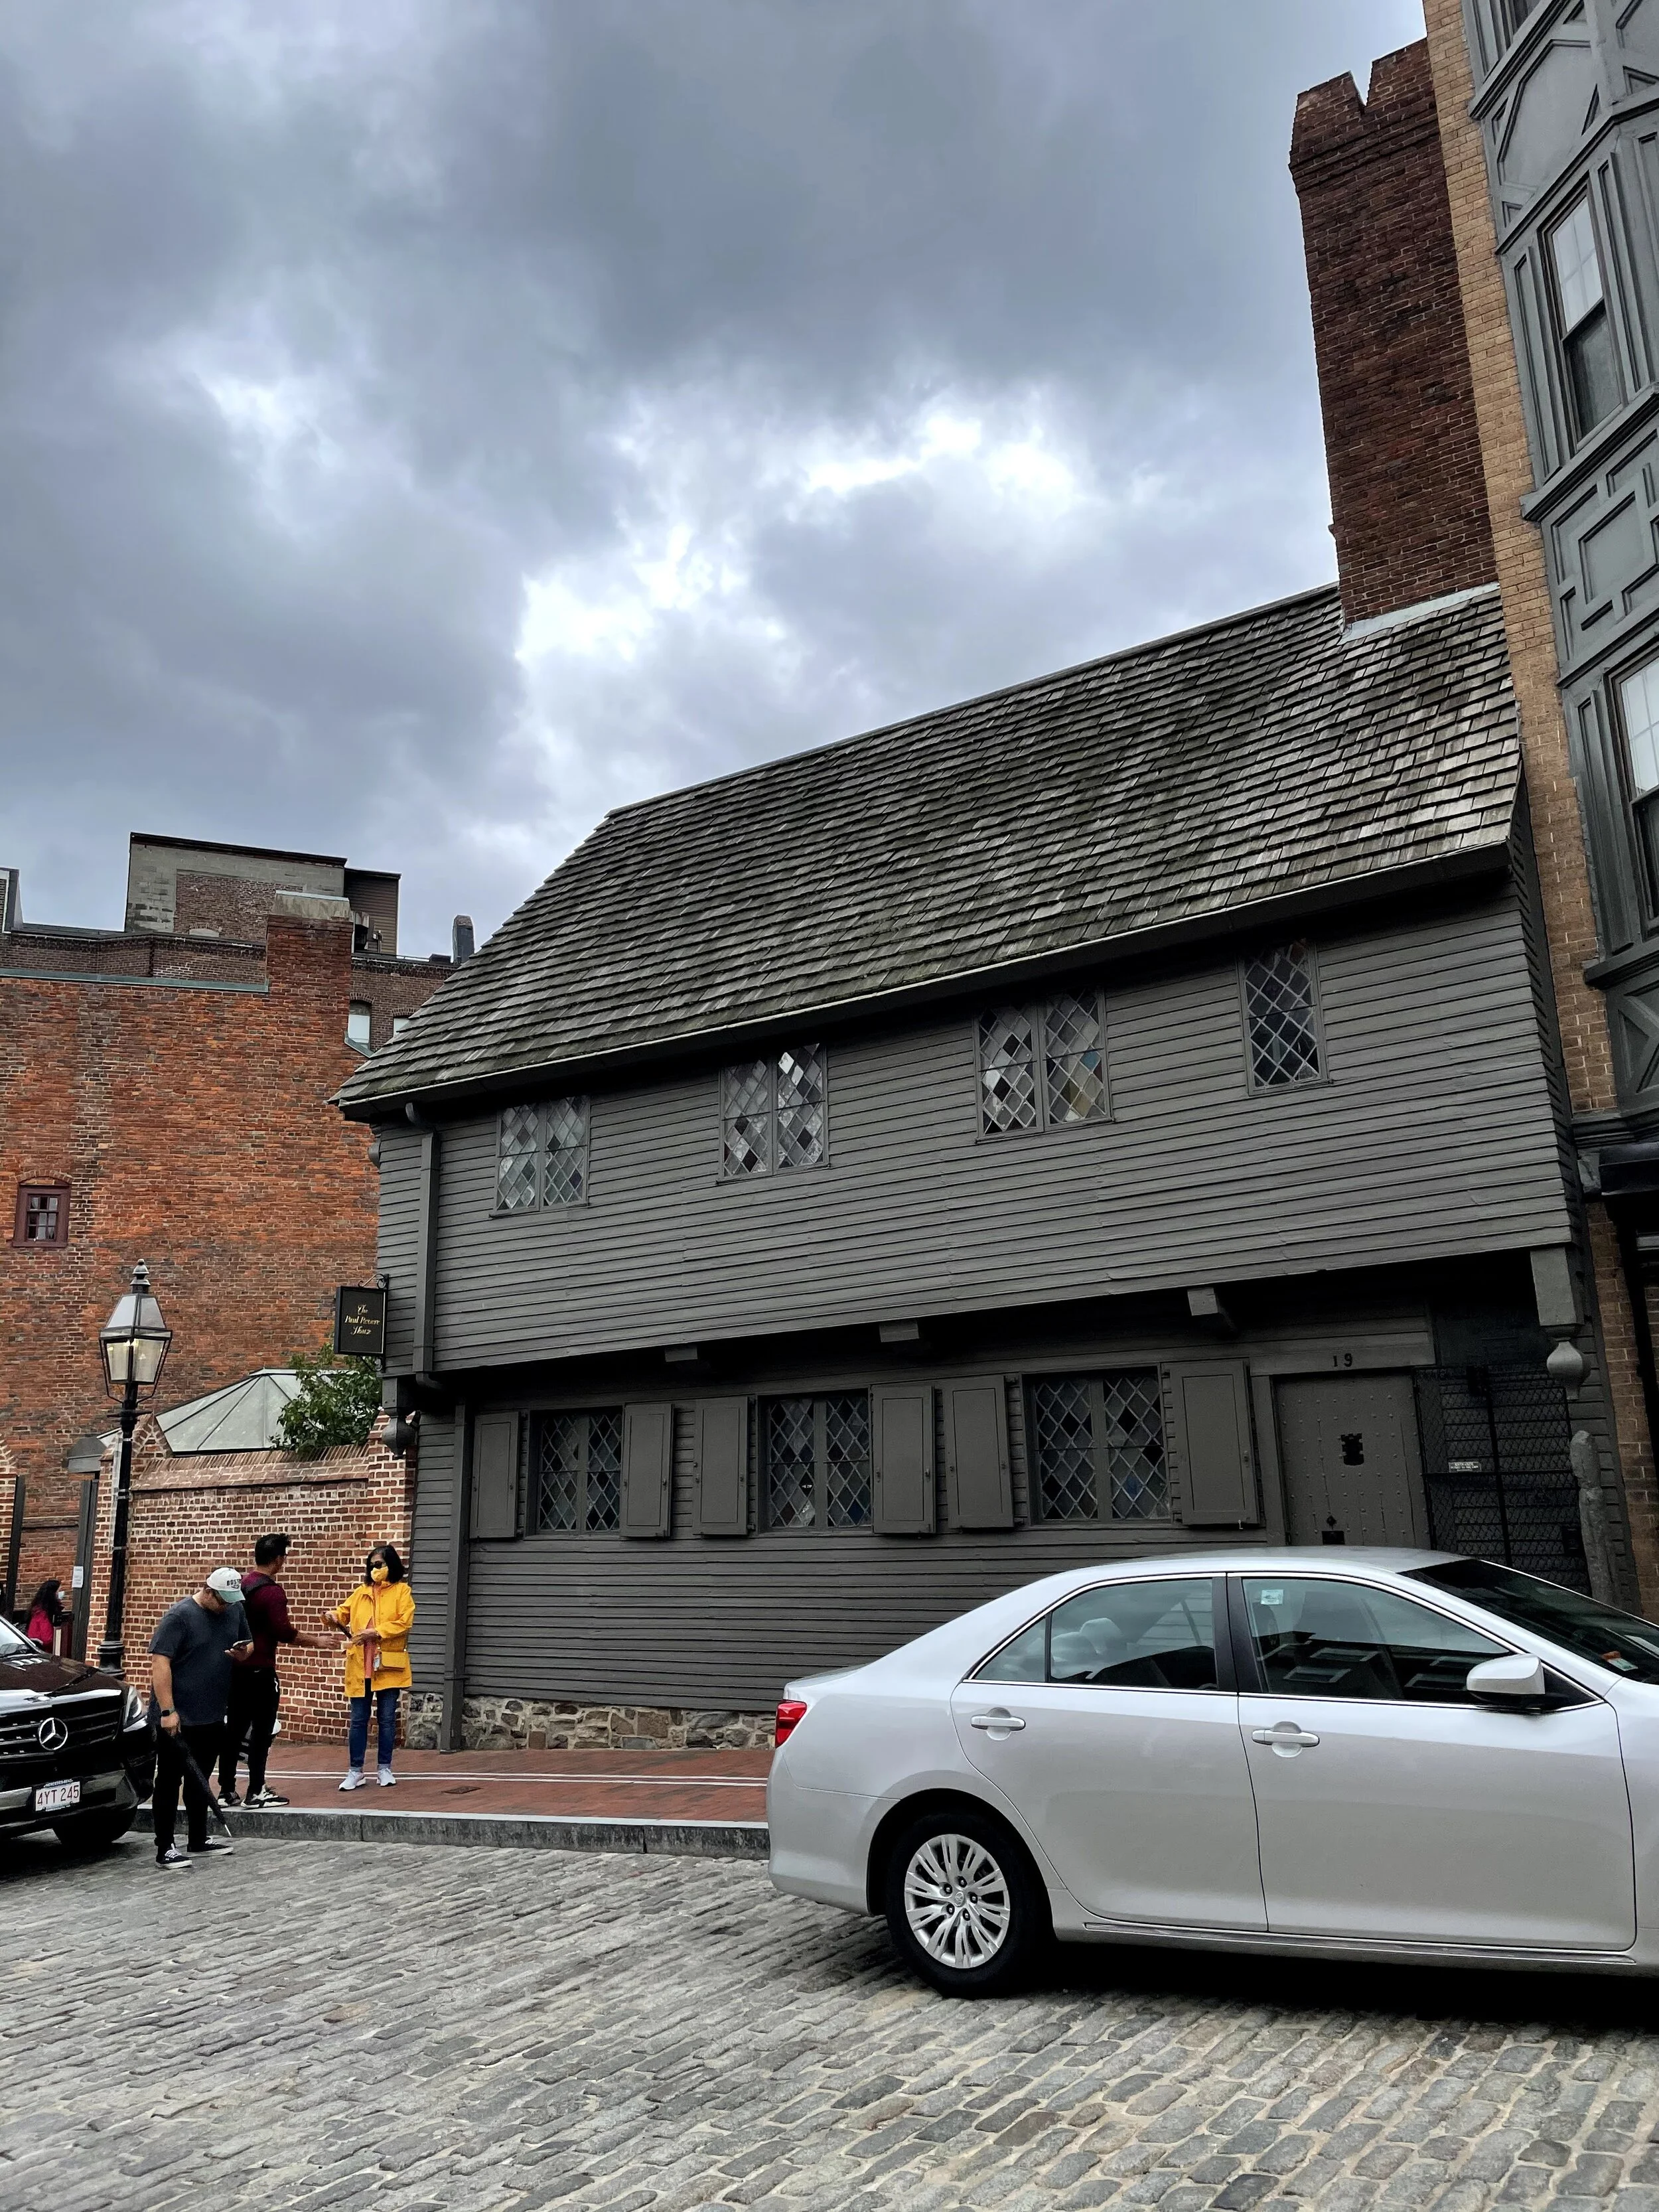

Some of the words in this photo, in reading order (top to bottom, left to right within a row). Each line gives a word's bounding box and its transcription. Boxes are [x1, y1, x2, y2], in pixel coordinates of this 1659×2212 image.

[358, 1304, 368, 1315] The
[344, 1315, 360, 1323] Paul
[350, 1326, 372, 1335] House
[1333, 1353, 1352, 1367] 19
[37, 1789, 58, 1805] 4YT
[60, 1785, 79, 1802] 245
